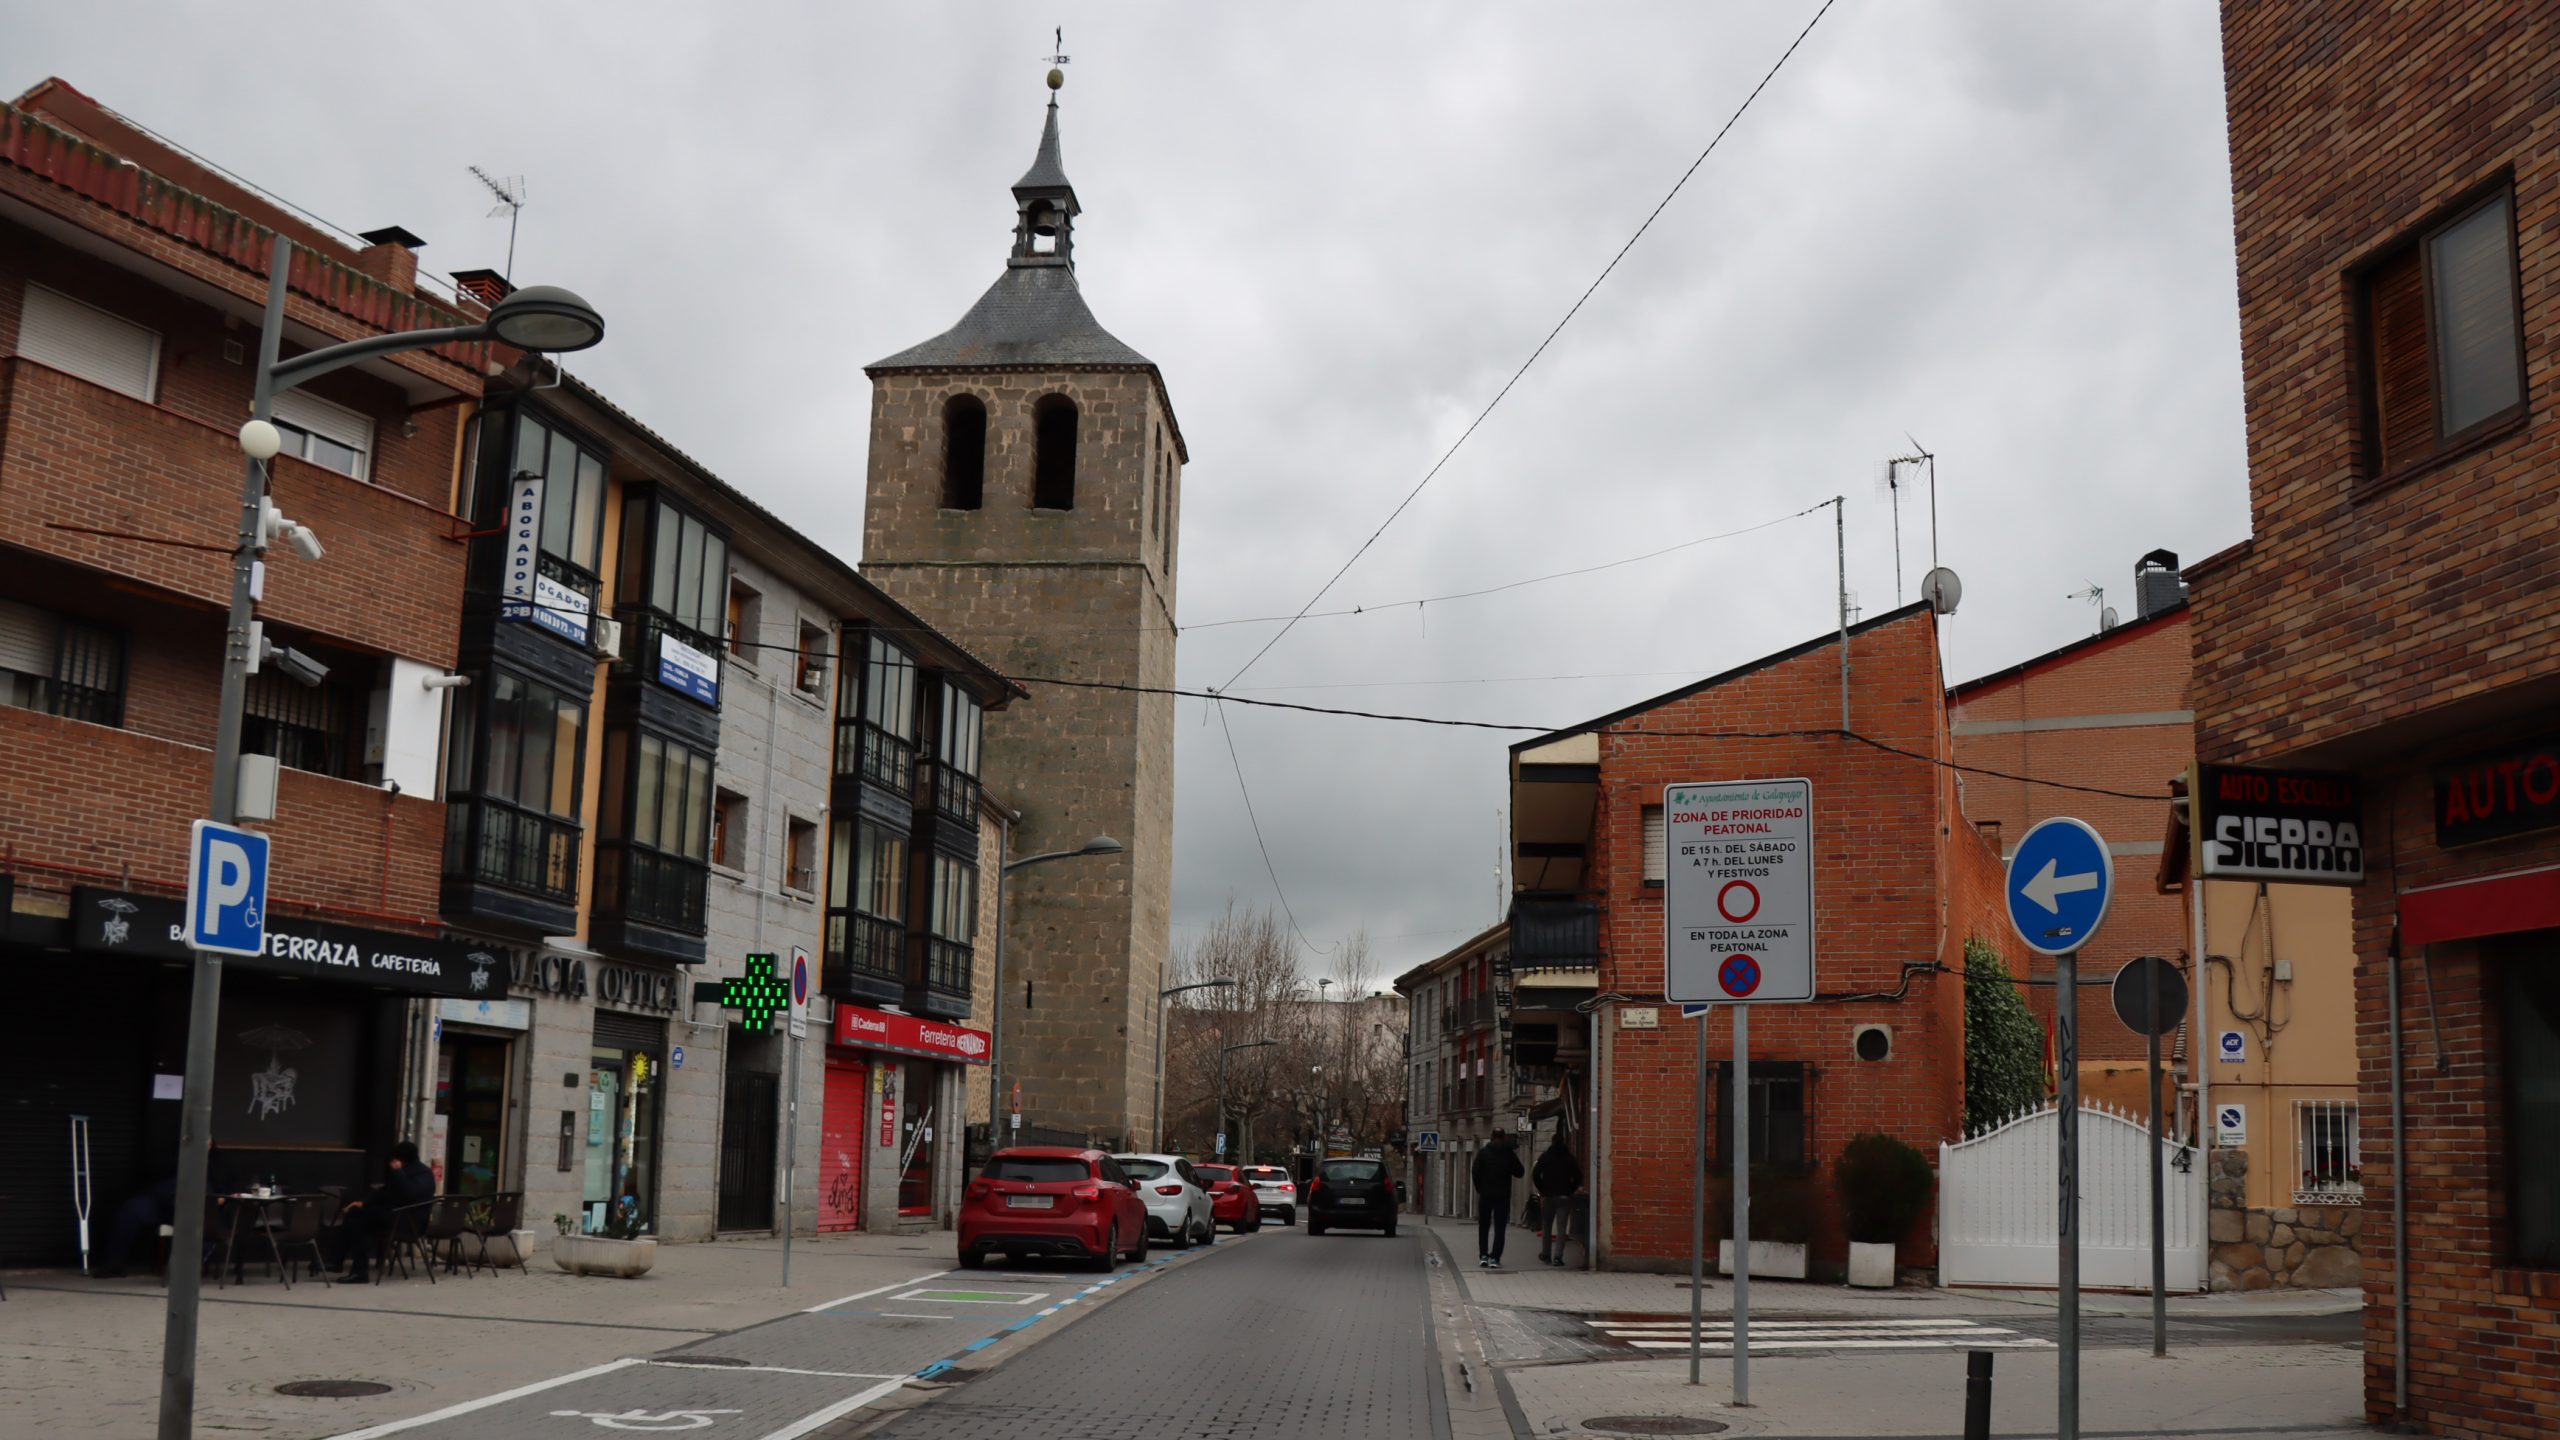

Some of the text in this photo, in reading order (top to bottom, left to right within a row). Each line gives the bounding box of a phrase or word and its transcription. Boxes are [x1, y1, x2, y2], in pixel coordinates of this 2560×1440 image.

[514, 487, 536, 596] ABOGADOS
[538, 582, 588, 613] OGADOS
[1699, 791, 1750, 806] Ayuntamiento
[1751, 789, 1760, 800] de
[2219, 773, 2353, 807] AUTO ESCUELA
[2445, 754, 2560, 828] AUTO
[1673, 808, 1803, 823] ZONA DE PRIORIDAD
[1704, 823, 1772, 835] PEATONAL
[1681, 842, 1796, 855] DE 15 h. DEL SÁBADO
[2216, 814, 2361, 873] SIERRA
[1693, 855, 1784, 867] A 7 h. DEL LUNES
[1708, 867, 1769, 878] Y FESTIVOS
[203, 838, 251, 936] P
[1690, 929, 1788, 940] EN TODA LA ZONA
[1710, 943, 1768, 952] PEATONAL
[371, 952, 441, 977] CAFETERÍA
[920, 1025, 956, 1048] Ferretería
